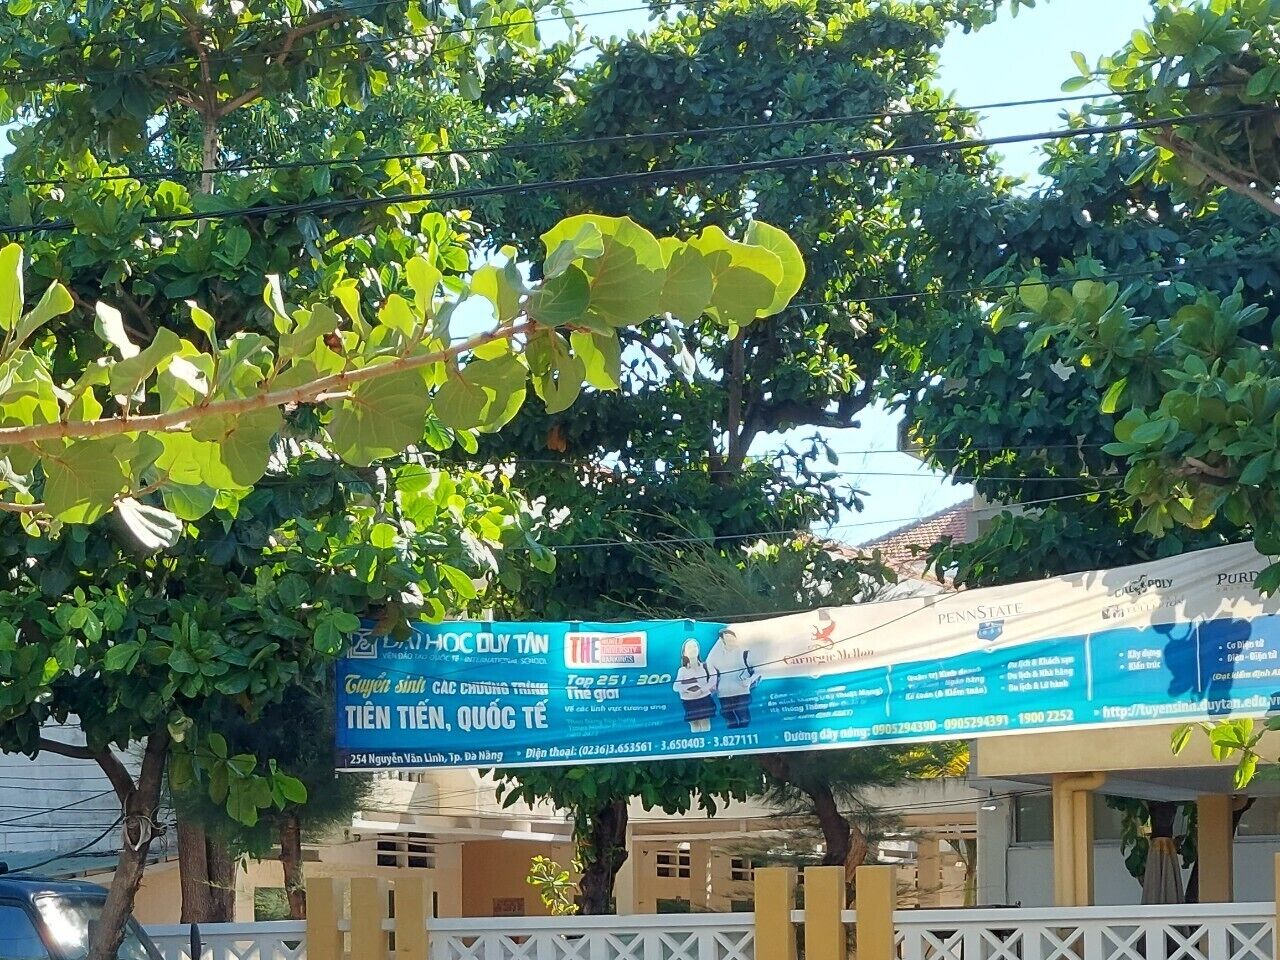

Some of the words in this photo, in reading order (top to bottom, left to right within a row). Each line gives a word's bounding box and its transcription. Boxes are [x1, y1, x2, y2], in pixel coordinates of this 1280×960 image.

[1216, 570, 1259, 586] PURD
[476, 632, 509, 654] DUY
[569, 636, 600, 663] THE
[783, 650, 836, 665] Carnegie
[344, 671, 392, 698] Tuyển
[394, 675, 427, 694] sinh
[567, 674, 594, 688] Top
[596, 674, 627, 686] 251
[636, 673, 672, 686] 300
[345, 701, 391, 730] TIÊN
[397, 698, 451, 732] TIẾN,
[457, 698, 516, 732] QUỐC
[522, 698, 549, 730] TẾ
[350, 753, 367, 765] 254
[368, 751, 404, 767] Nguyễn
[404, 752, 423, 763] Văn
[423, 752, 447, 763] Linh,
[448, 752, 463, 764] Tp.
[464, 751, 477, 761] Đà
[478, 750, 504, 762] Nẵng
[525, 747, 548, 759] Điện
[549, 746, 577, 758] thoại:
[578, 741, 653, 757] (0236)3.653561
[661, 736, 706, 751] 3.650403
[713, 733, 759, 748] 3.827111
[784, 730, 818, 743] Đường
[872, 719, 937, 736] 0905294390
[1018, 710, 1045, 724] 1900
[1046, 708, 1074, 722] 2252
